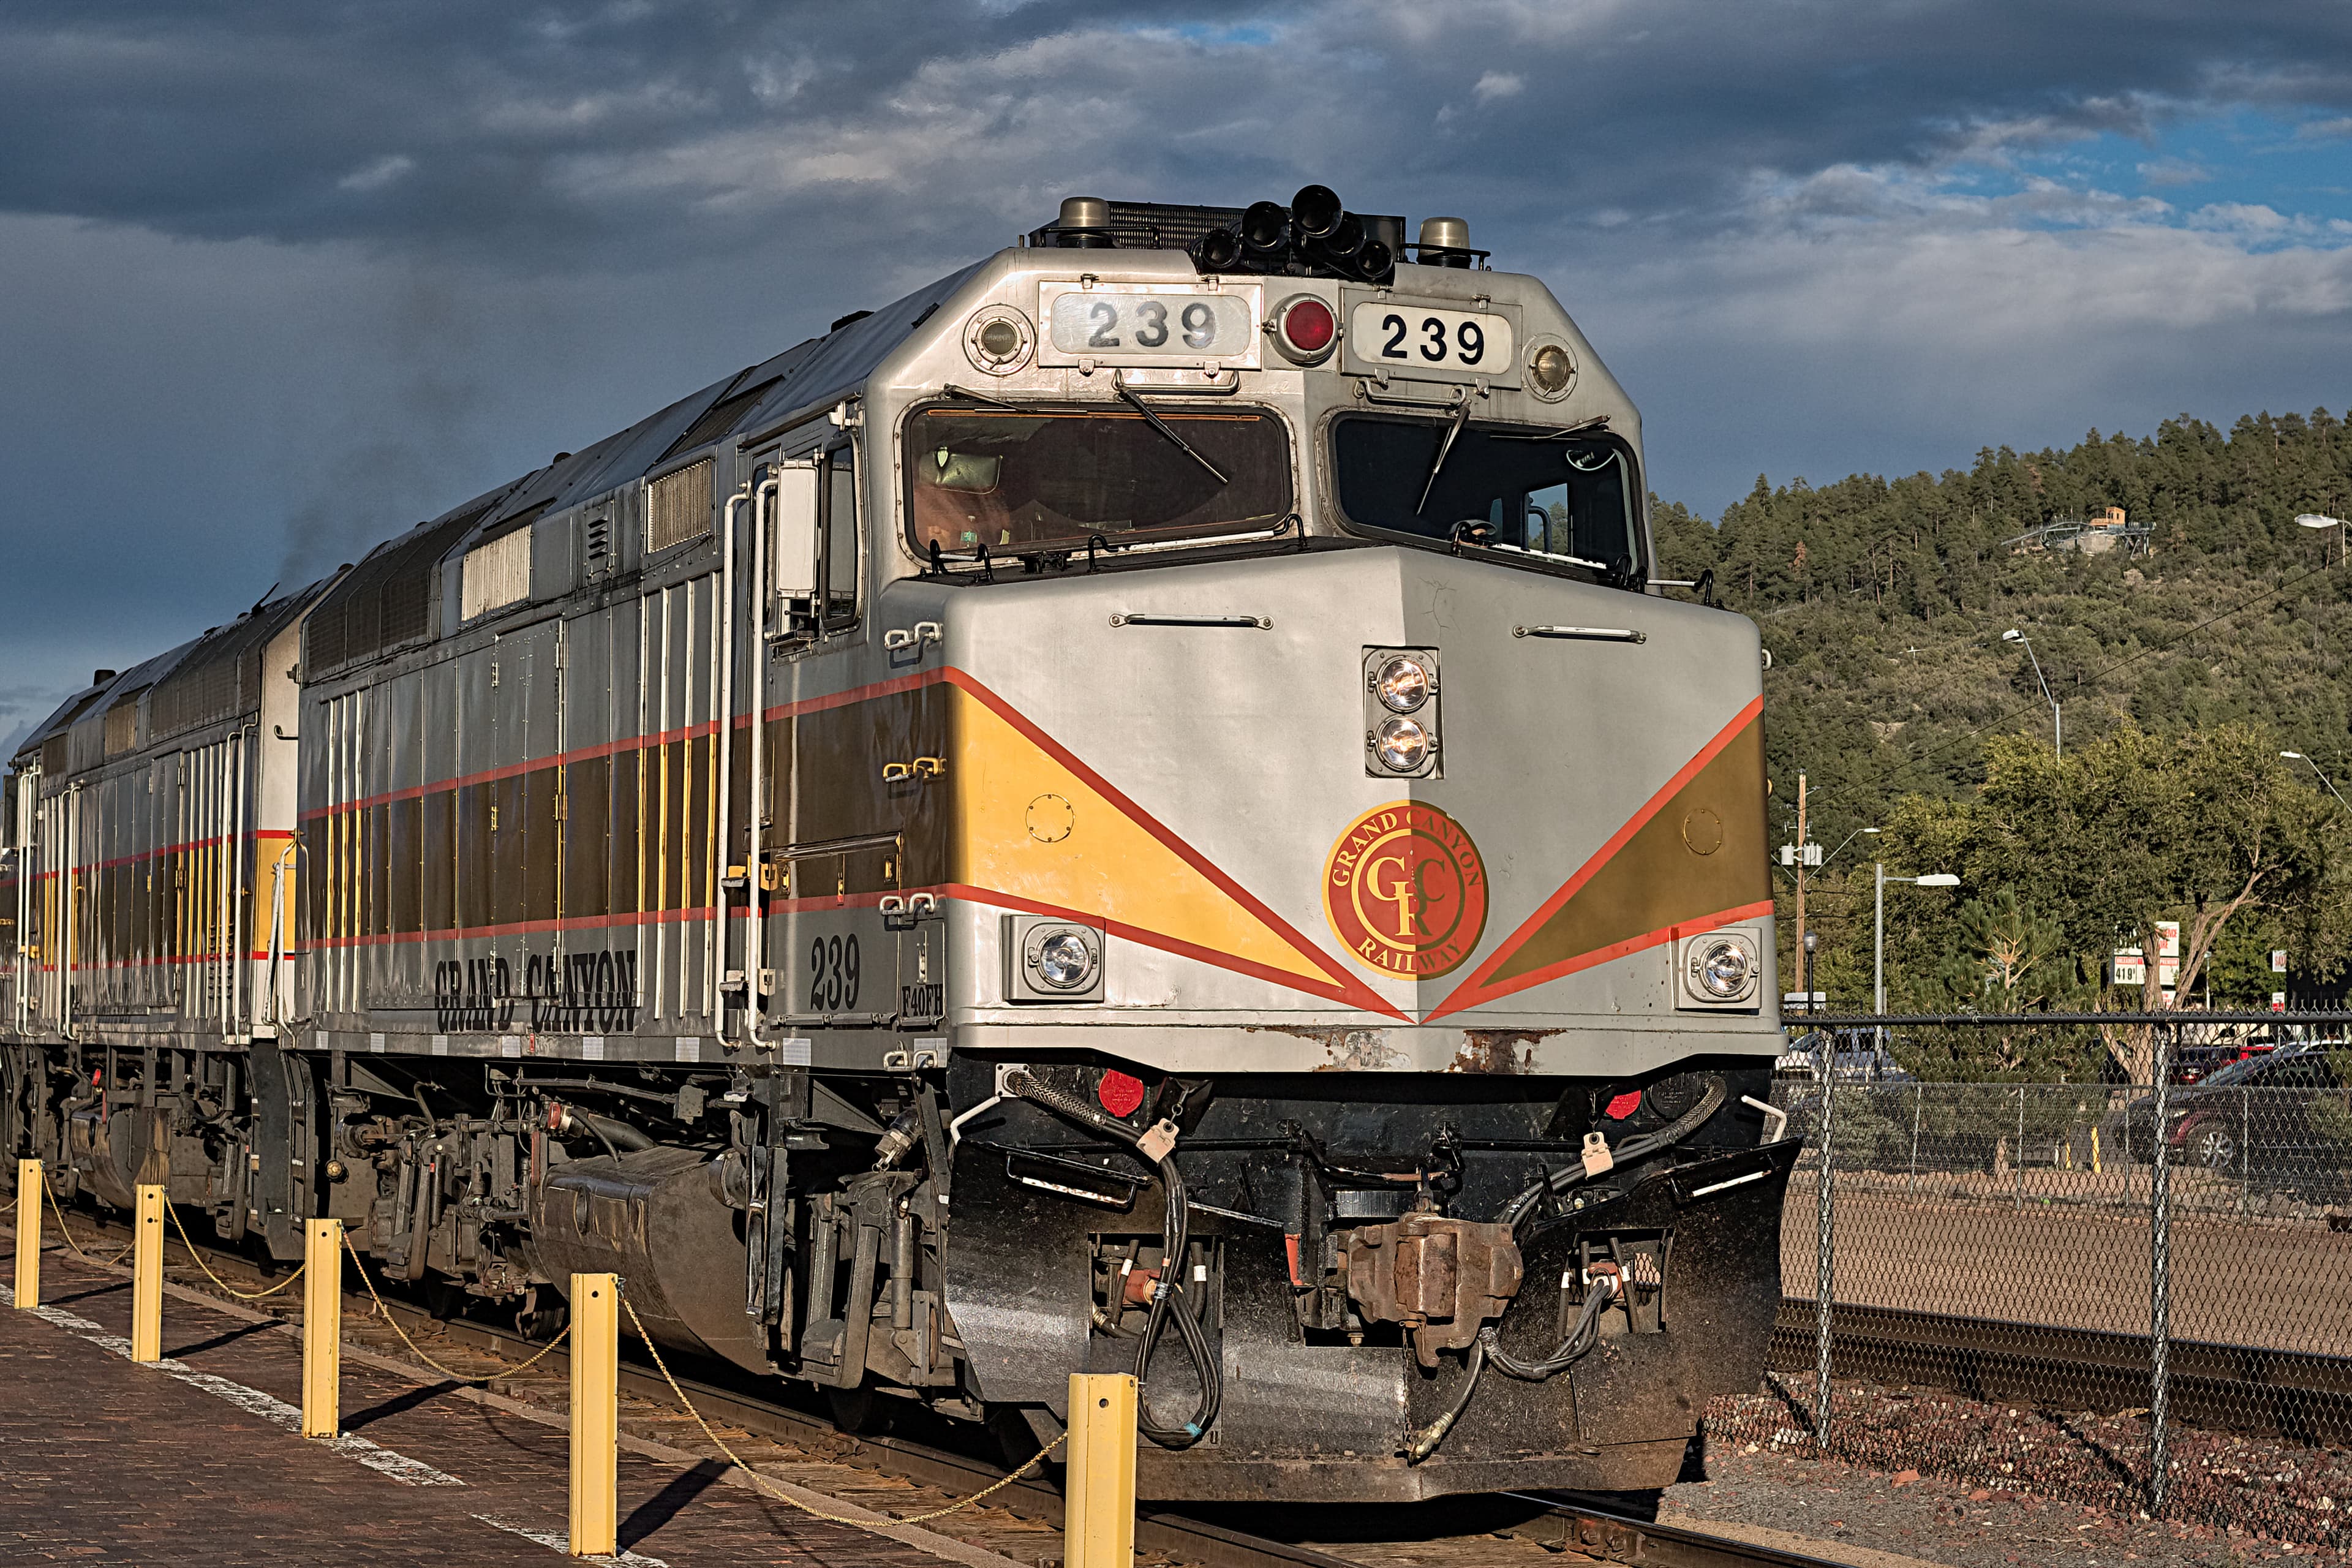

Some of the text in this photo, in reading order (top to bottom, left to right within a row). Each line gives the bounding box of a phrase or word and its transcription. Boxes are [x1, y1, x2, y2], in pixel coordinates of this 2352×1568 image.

[1088, 301, 1216, 349] 239
[1382, 314, 1485, 365] 239
[1332, 809, 1482, 888] GRAND CANYON
[810, 933, 861, 1011] 239
[1357, 935, 1461, 972] RAILWAY
[434, 949, 636, 1034] GRAND CANYON
[902, 983, 943, 1017] F40FH
